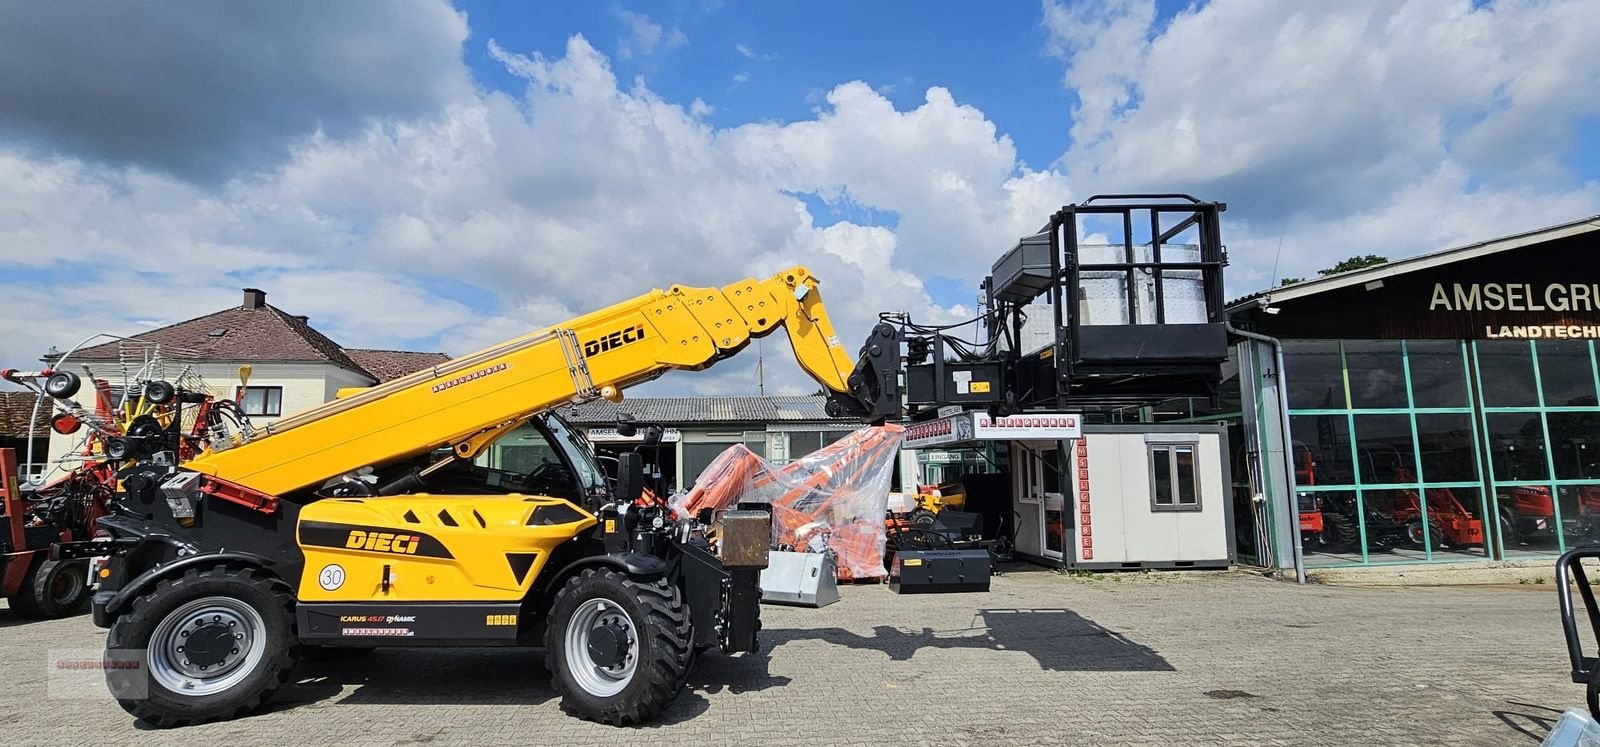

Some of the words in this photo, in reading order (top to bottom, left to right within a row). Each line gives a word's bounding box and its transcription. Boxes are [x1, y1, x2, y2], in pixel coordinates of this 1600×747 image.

[1486, 325, 1600, 338] LANDTECH
[584, 324, 645, 358] DIECI
[980, 418, 1075, 428] ASELGRUBER
[345, 530, 420, 554] DIECI
[322, 569, 342, 586] 30
